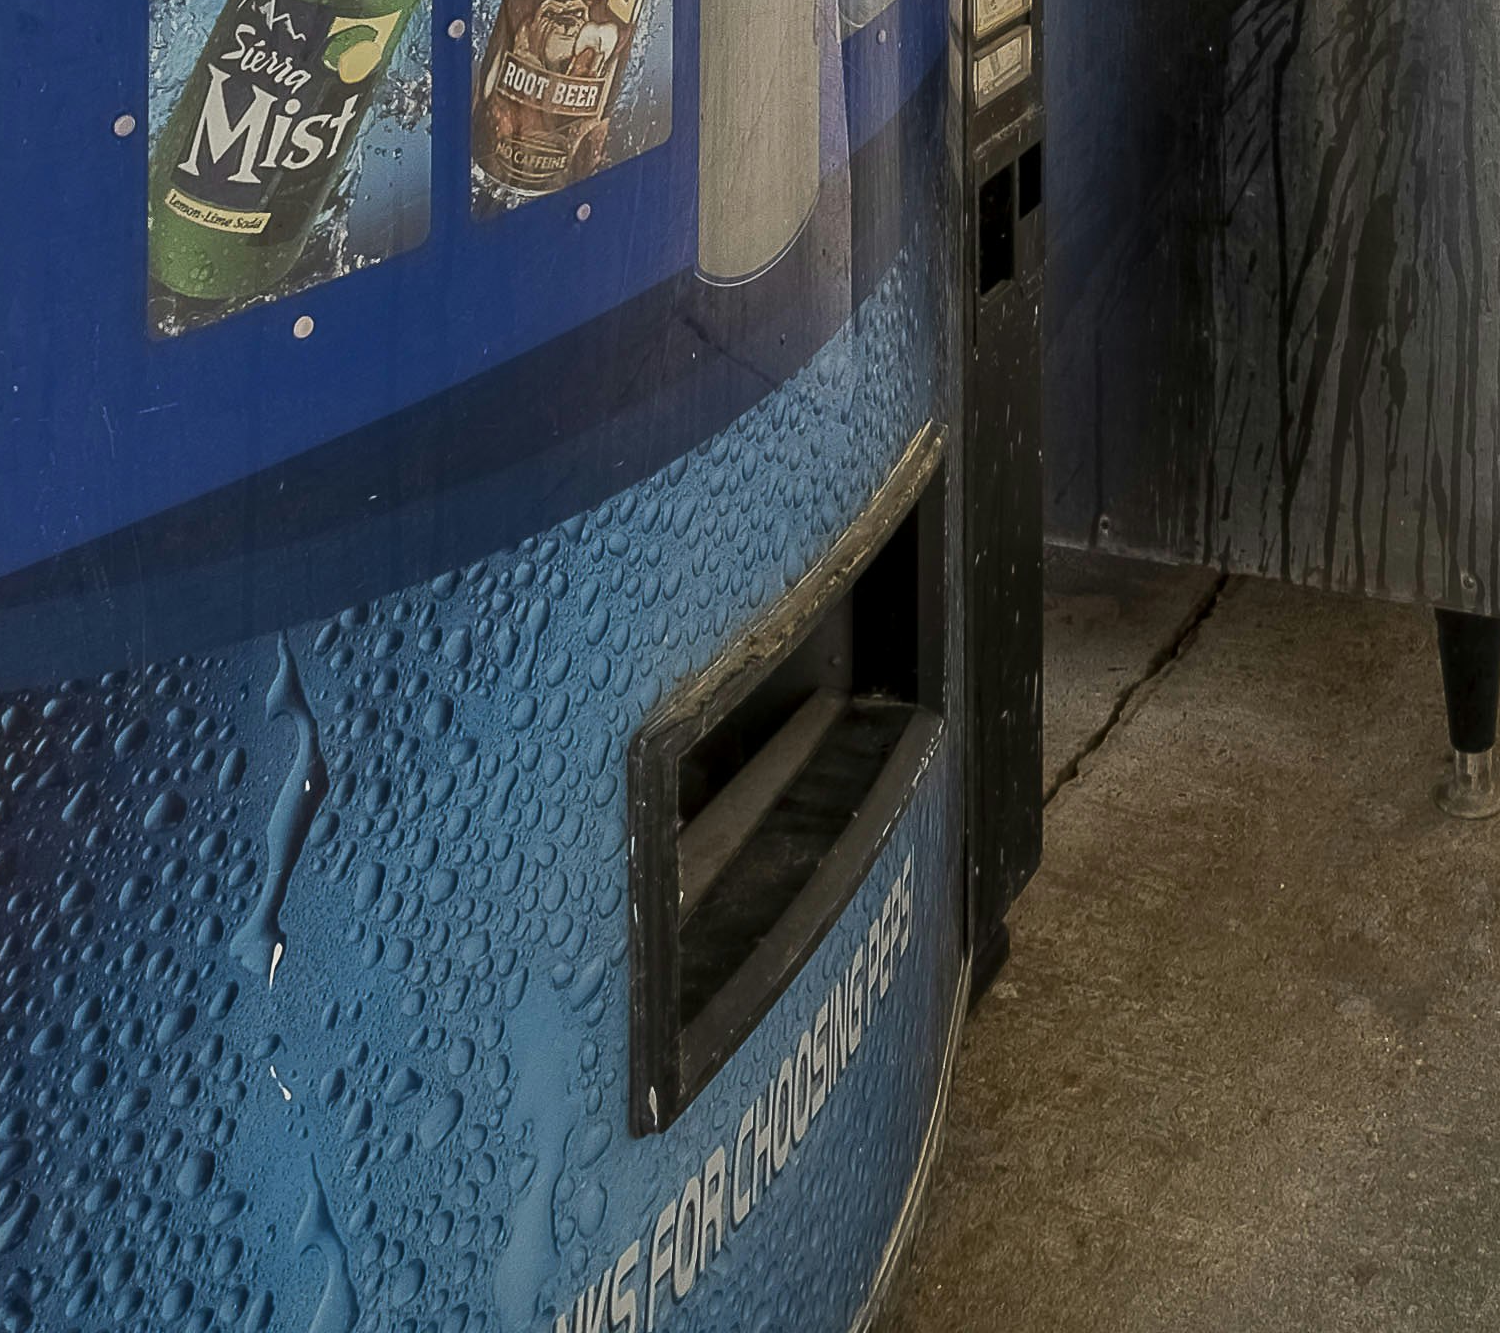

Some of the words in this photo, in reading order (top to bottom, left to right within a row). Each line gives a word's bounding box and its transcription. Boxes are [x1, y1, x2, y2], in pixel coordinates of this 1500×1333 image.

[220, 23, 313, 94] Sierra
[504, 61, 551, 101] ROOT
[551, 81, 599, 109] BEER
[177, 62, 360, 184] Mist
[512, 145, 568, 170] CAFFEINE
[649, 1149, 727, 1332] FOR
[731, 941, 864, 1224] CHOOSING
